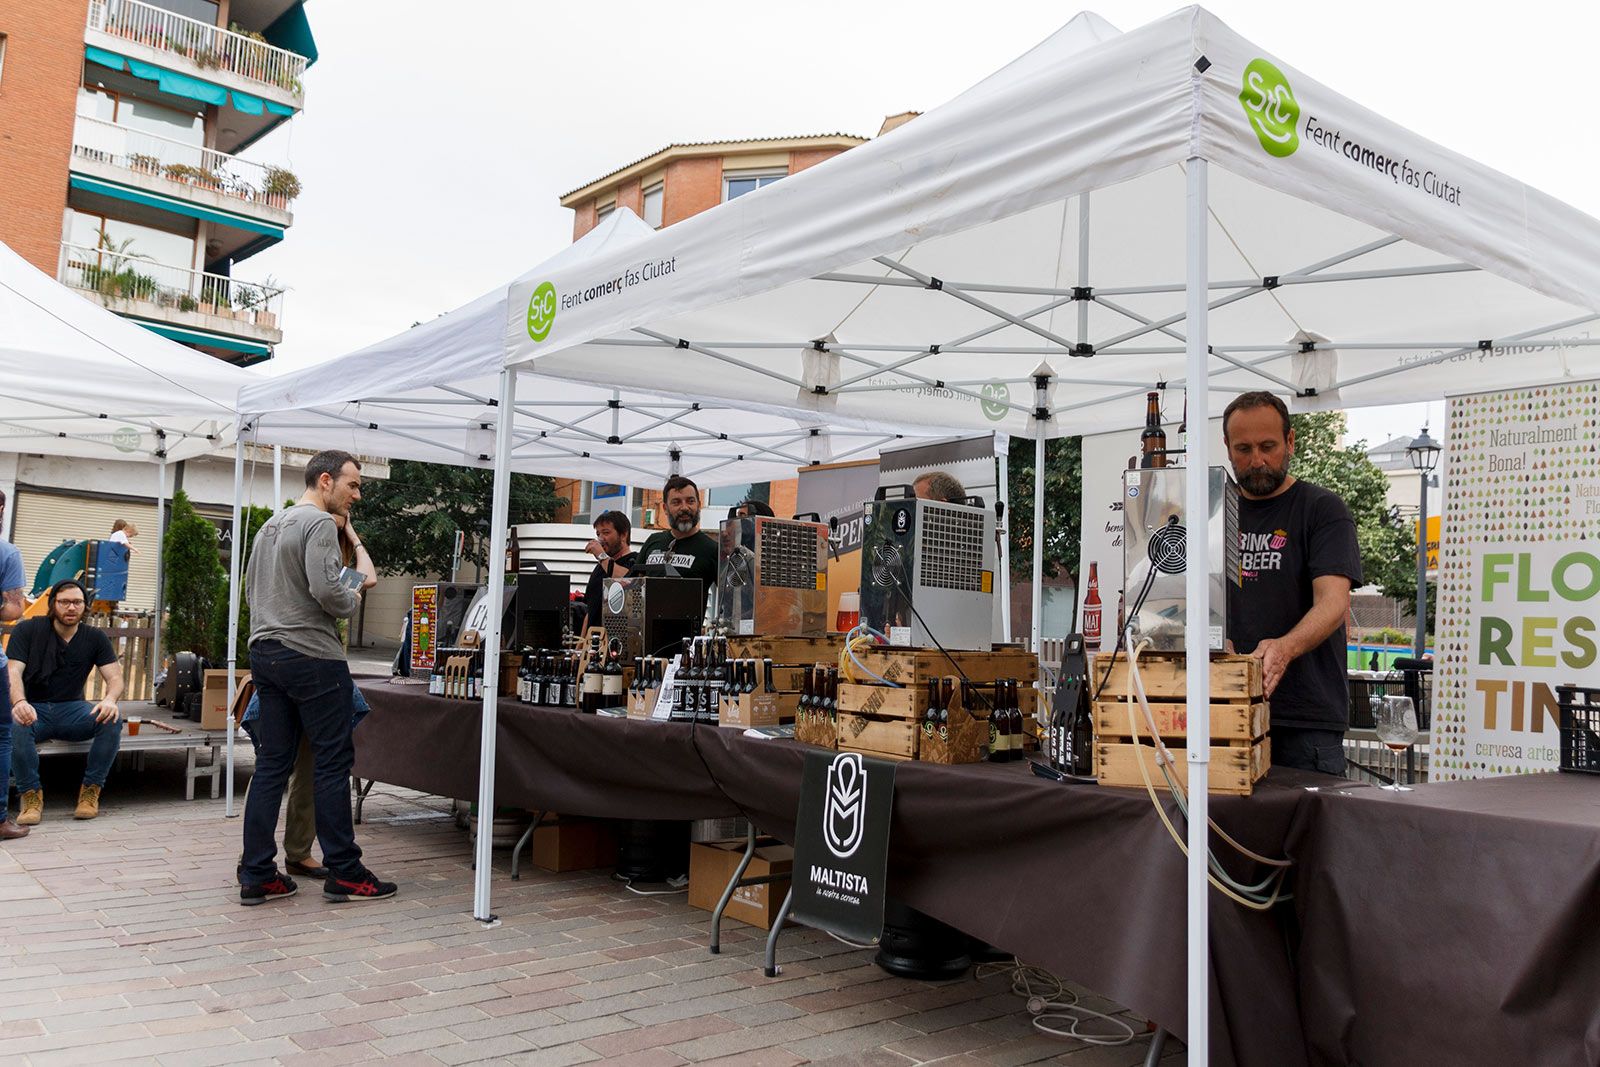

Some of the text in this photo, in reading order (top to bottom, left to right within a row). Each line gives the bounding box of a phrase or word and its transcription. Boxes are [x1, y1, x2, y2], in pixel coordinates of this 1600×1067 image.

[1305, 116, 1461, 206] Fent comerç fas Ciutat
[561, 256, 676, 310] Fent comerç fas Ciutat
[1489, 424, 1577, 448] Naturalment
[1488, 452, 1526, 473] Bona!
[1242, 551, 1282, 570] BEER
[1481, 552, 1600, 602] FLO
[1479, 616, 1597, 669] RES
[1475, 743, 1560, 762] cervesa artes
[810, 864, 869, 895] MALTISTA
